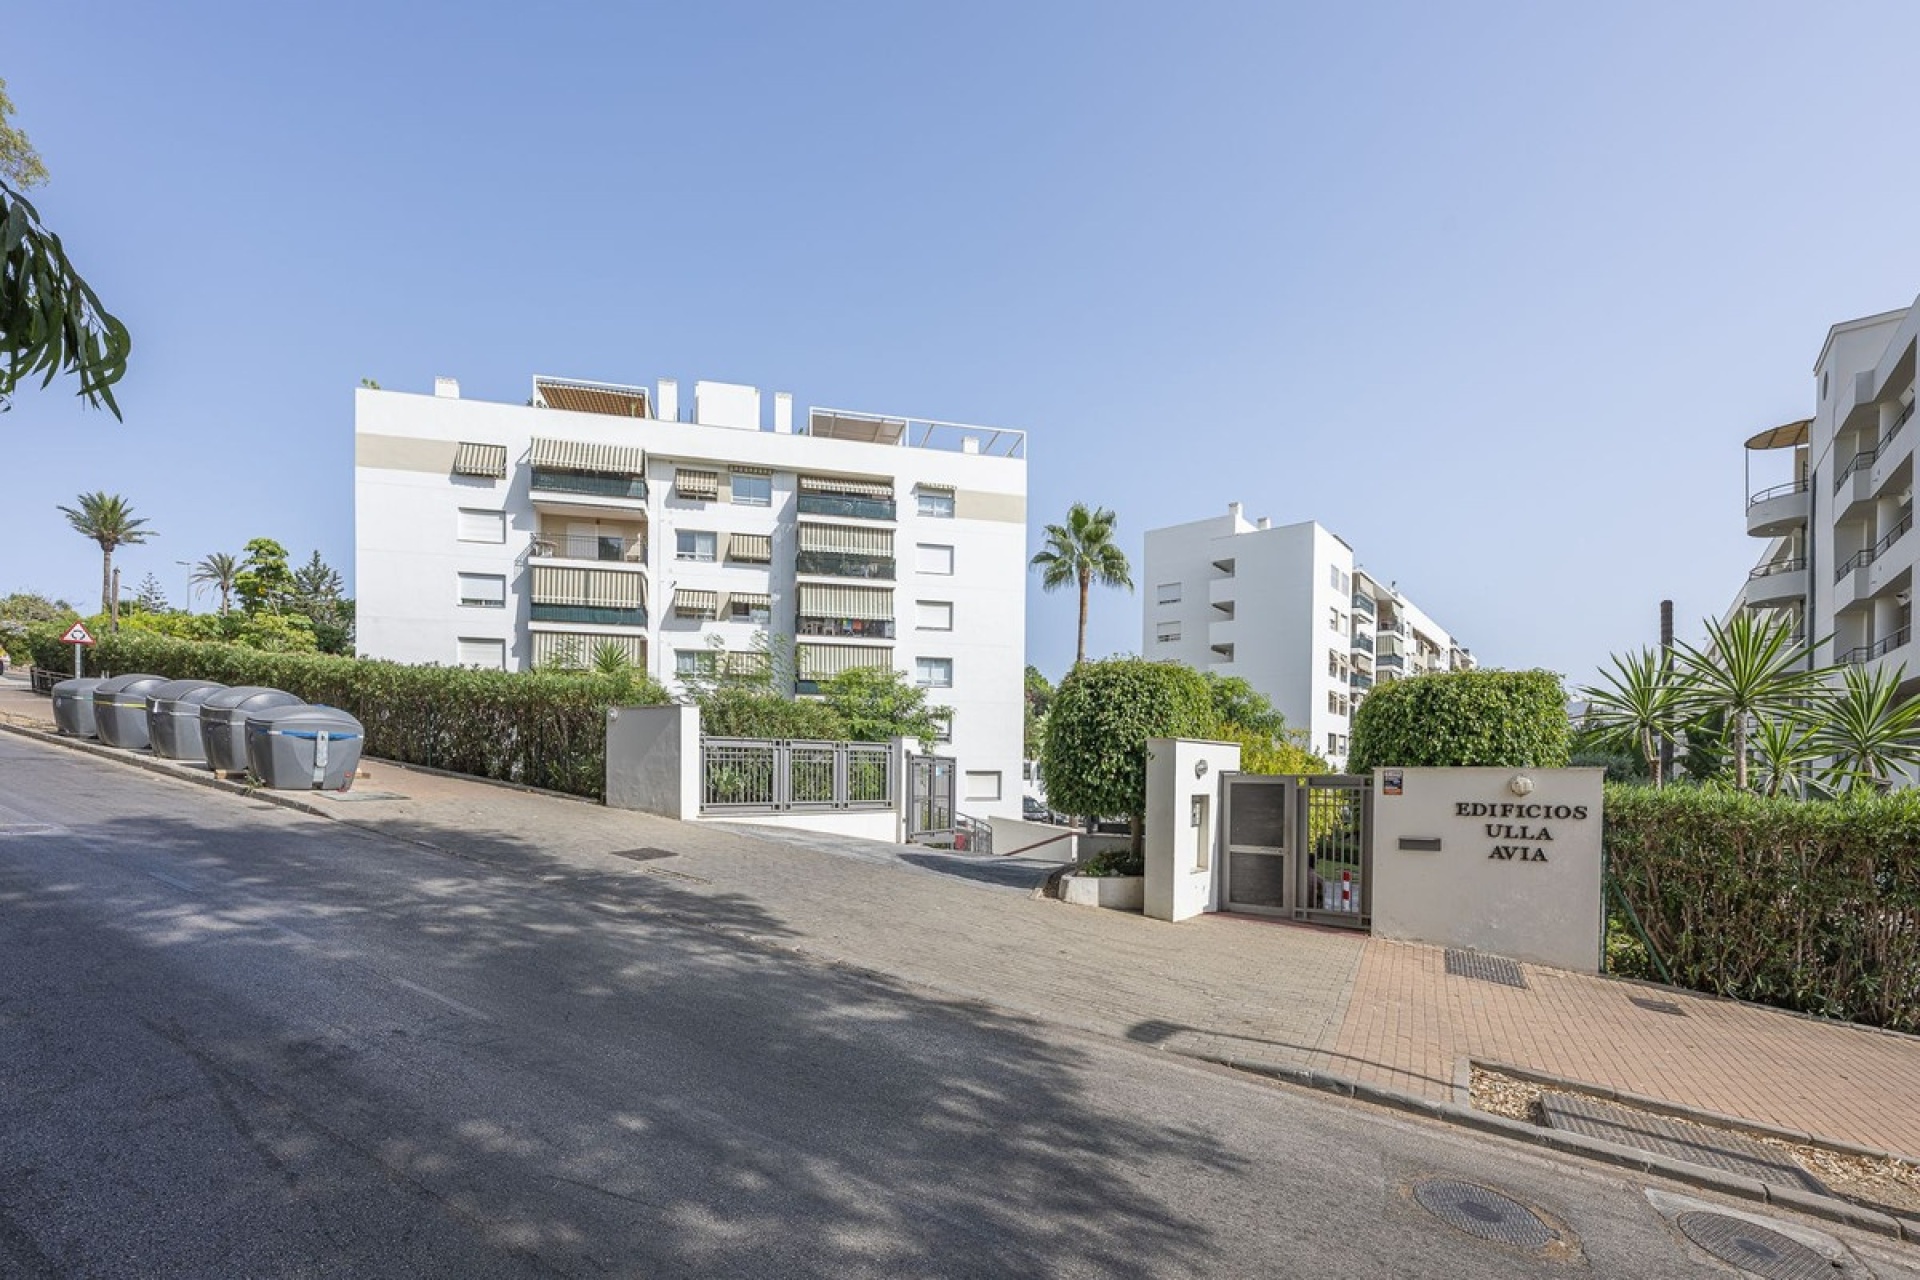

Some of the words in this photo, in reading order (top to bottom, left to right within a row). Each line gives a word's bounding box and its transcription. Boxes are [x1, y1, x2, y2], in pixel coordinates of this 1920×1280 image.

[1455, 802, 1588, 820] EDIFICIOS
[1485, 823, 1554, 841] ULLA
[1488, 845, 1548, 862] AVIA
